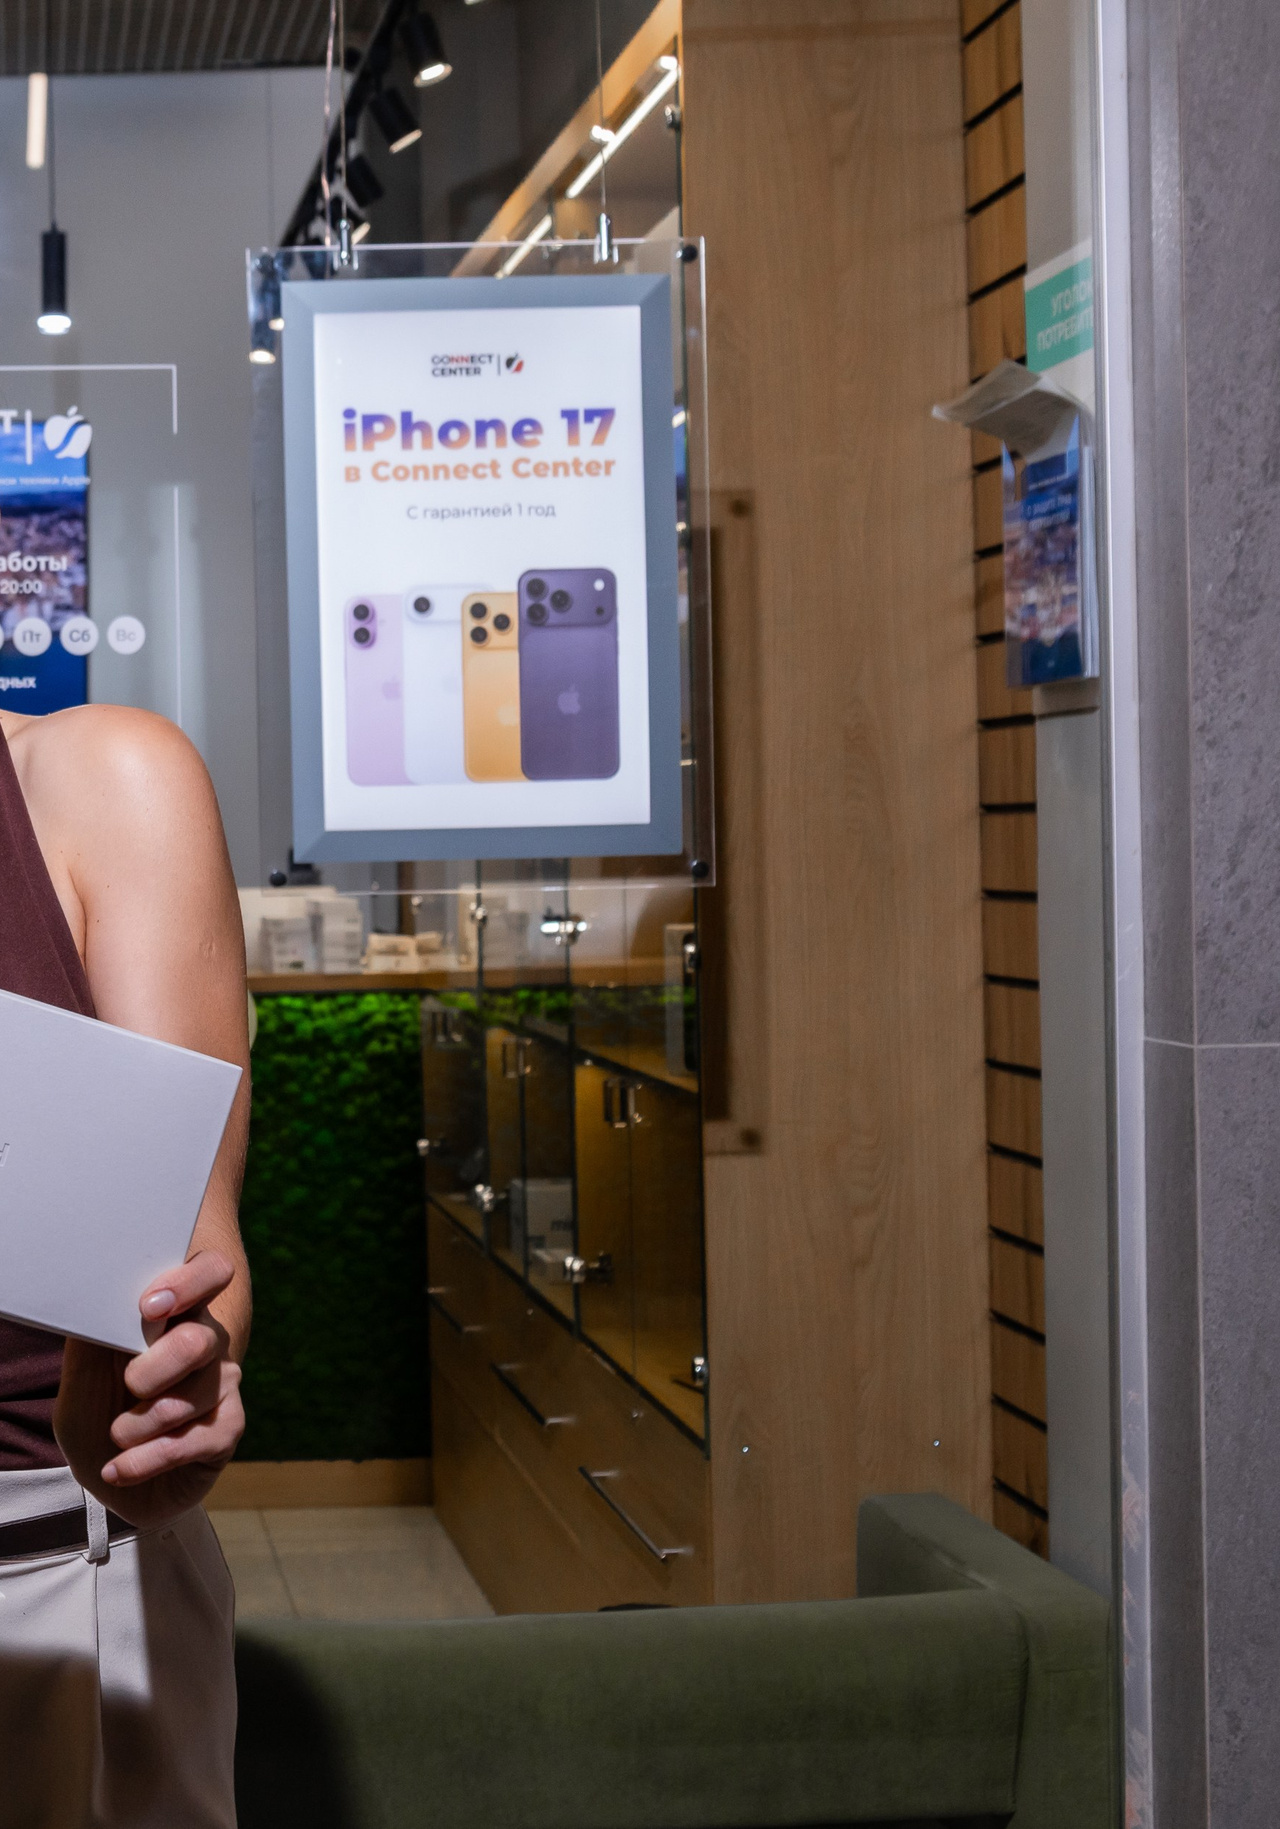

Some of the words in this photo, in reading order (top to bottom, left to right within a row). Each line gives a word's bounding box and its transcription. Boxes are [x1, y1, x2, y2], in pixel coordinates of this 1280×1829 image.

[431, 354, 494, 365] CONNECT
[432, 367, 481, 377] CENTER
[342, 408, 544, 451] iPhone
[560, 408, 616, 446] 17
[372, 459, 502, 483] Connect
[511, 457, 616, 479] Center
[423, 502, 513, 522] гарантией
[528, 504, 557, 517] год
[0, 578, 43, 594] 20:00
[22, 630, 42, 644] Пт
[69, 629, 91, 643] Сб
[115, 629, 136, 642] Вс
